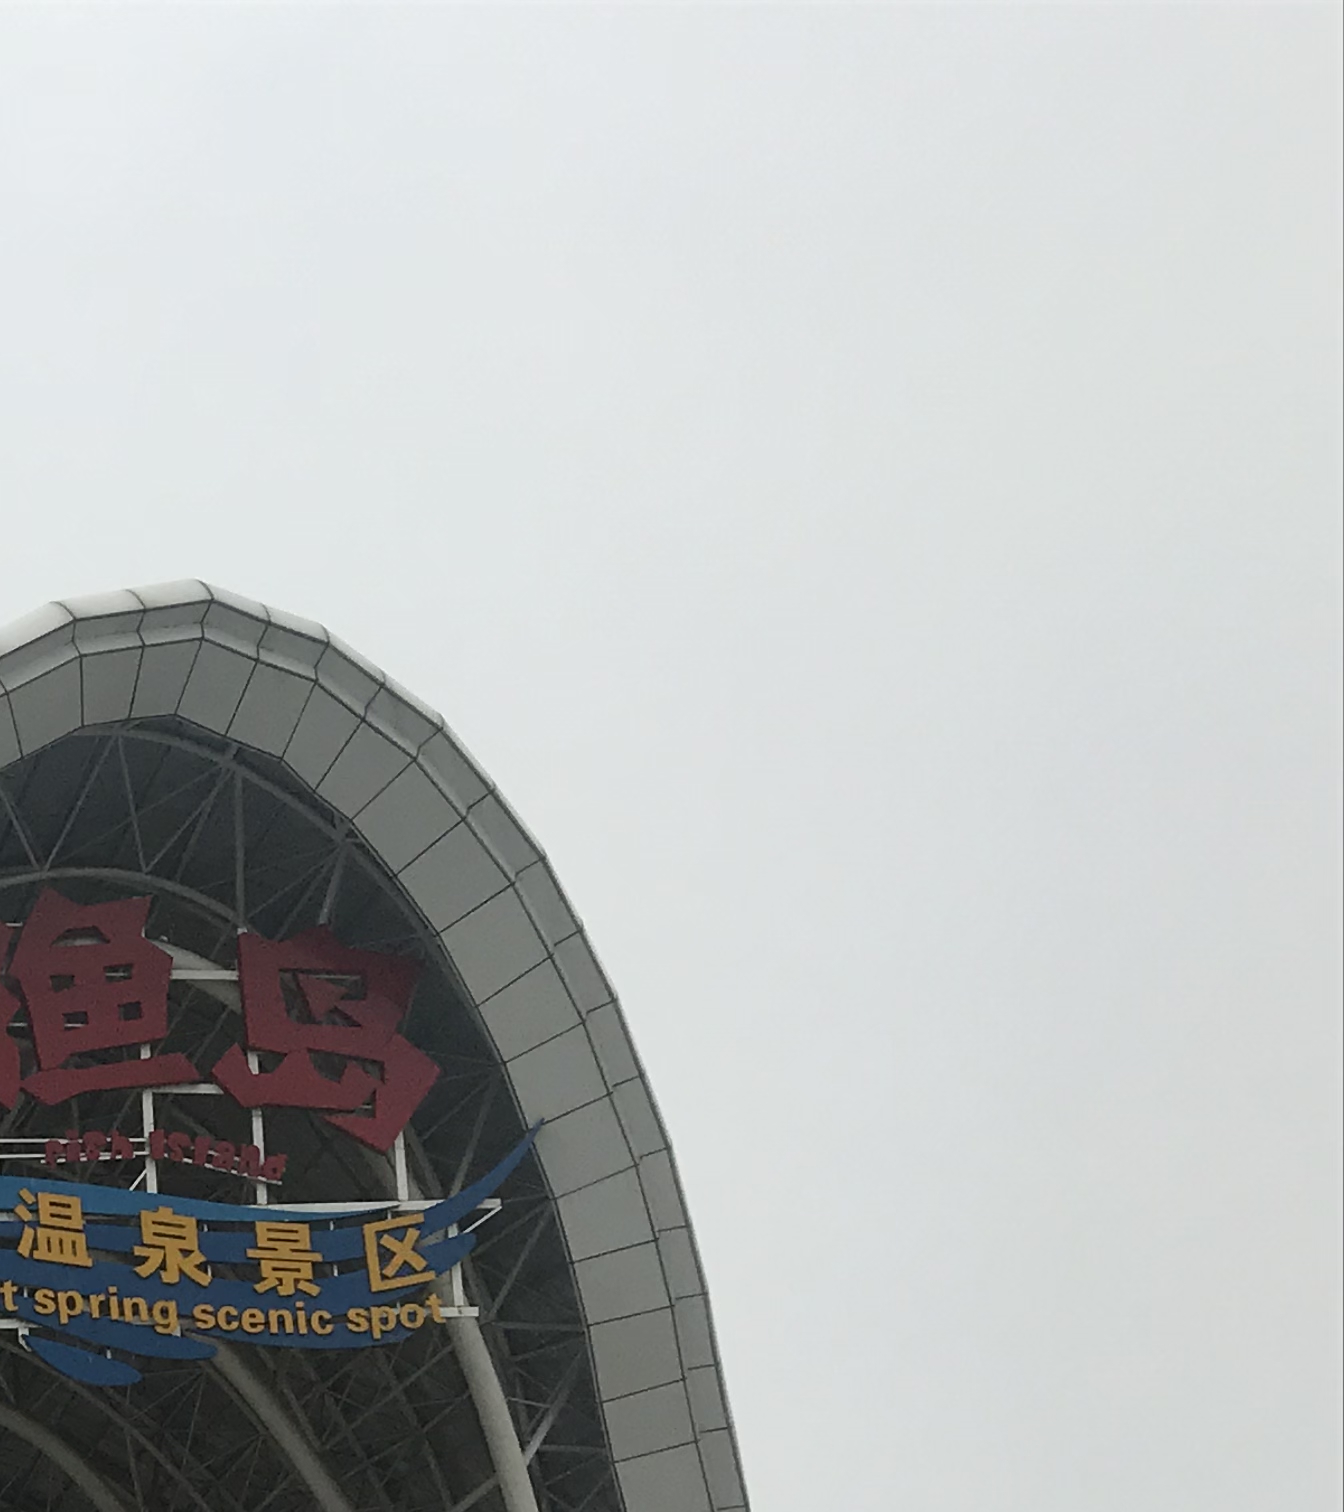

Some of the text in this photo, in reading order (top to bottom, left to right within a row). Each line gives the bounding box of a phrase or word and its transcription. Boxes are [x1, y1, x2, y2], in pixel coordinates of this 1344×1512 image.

[33, 1285, 179, 1336] spring
[195, 1300, 334, 1335] scenic
[346, 1291, 447, 1341] spot
